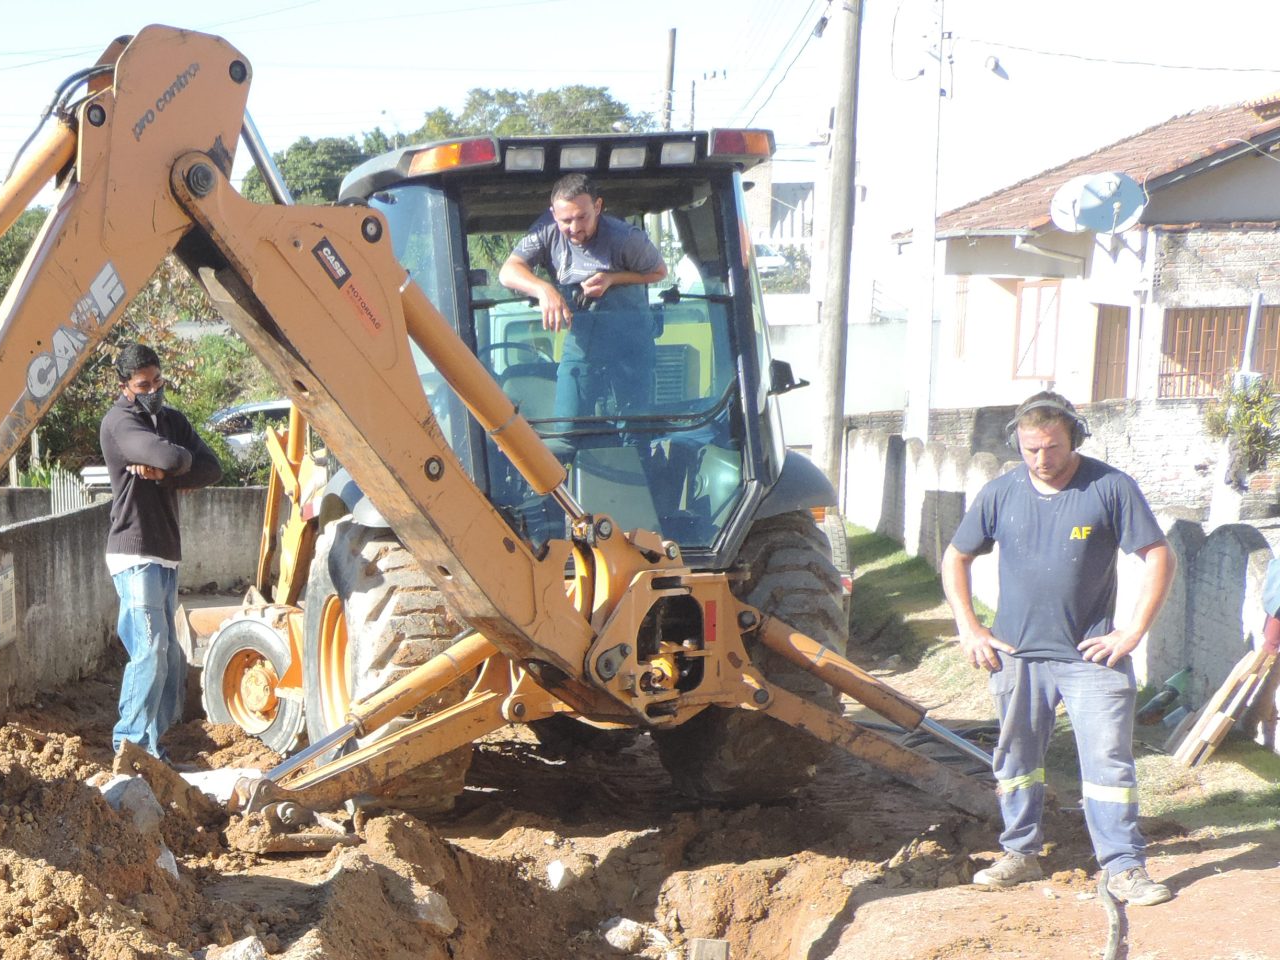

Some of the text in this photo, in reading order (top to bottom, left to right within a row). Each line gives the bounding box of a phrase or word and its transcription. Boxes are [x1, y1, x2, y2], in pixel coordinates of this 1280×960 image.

[132, 108, 155, 142] pro
[322, 247, 346, 278] CASE
[1069, 526, 1092, 540] AF
